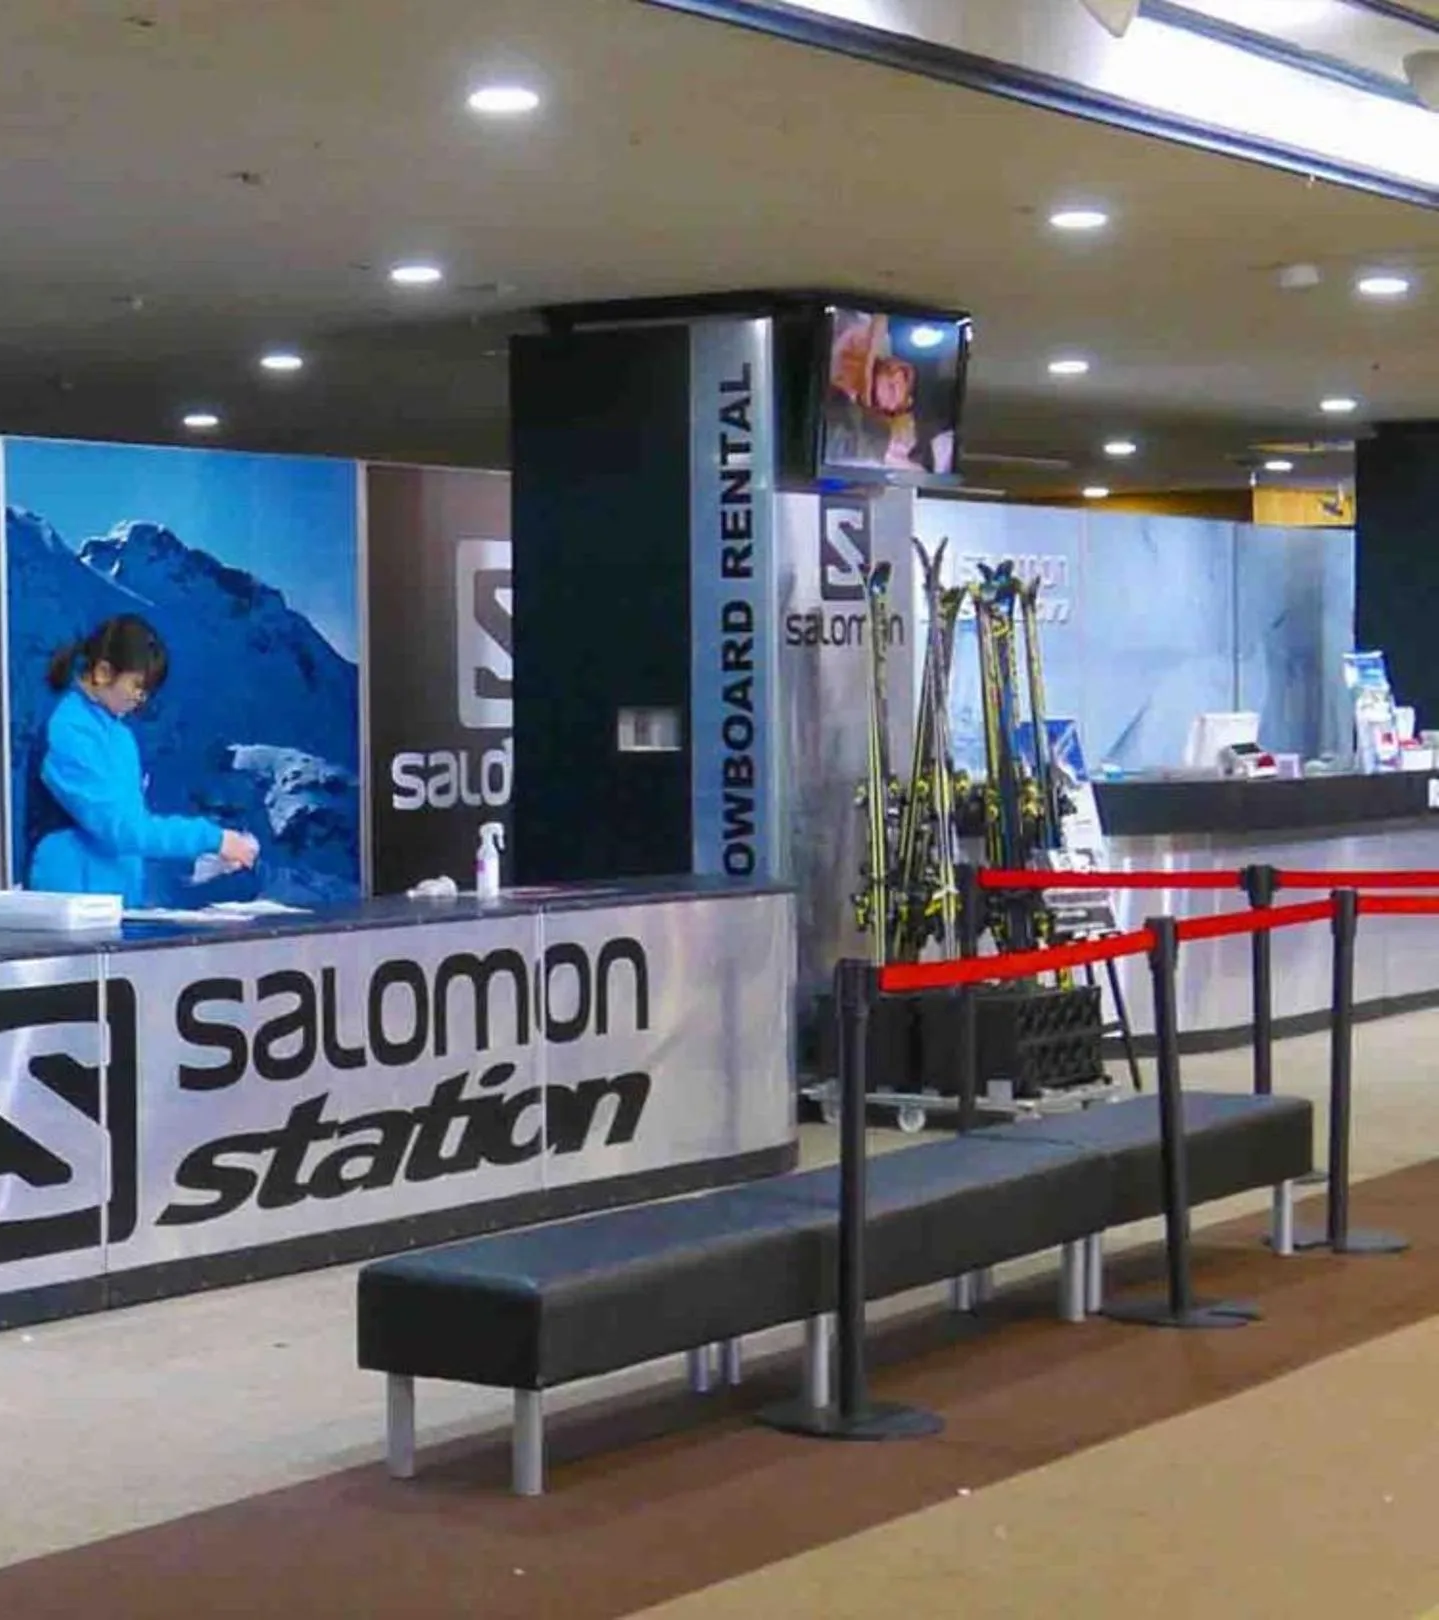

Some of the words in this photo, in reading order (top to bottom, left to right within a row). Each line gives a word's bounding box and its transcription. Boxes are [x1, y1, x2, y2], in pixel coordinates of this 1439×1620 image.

[719, 362, 754, 580] RENTAL
[785, 613, 905, 647] salomn
[722, 599, 756, 878] OWBOARD
[175, 936, 650, 1092] salomon
[154, 1061, 652, 1226] station
